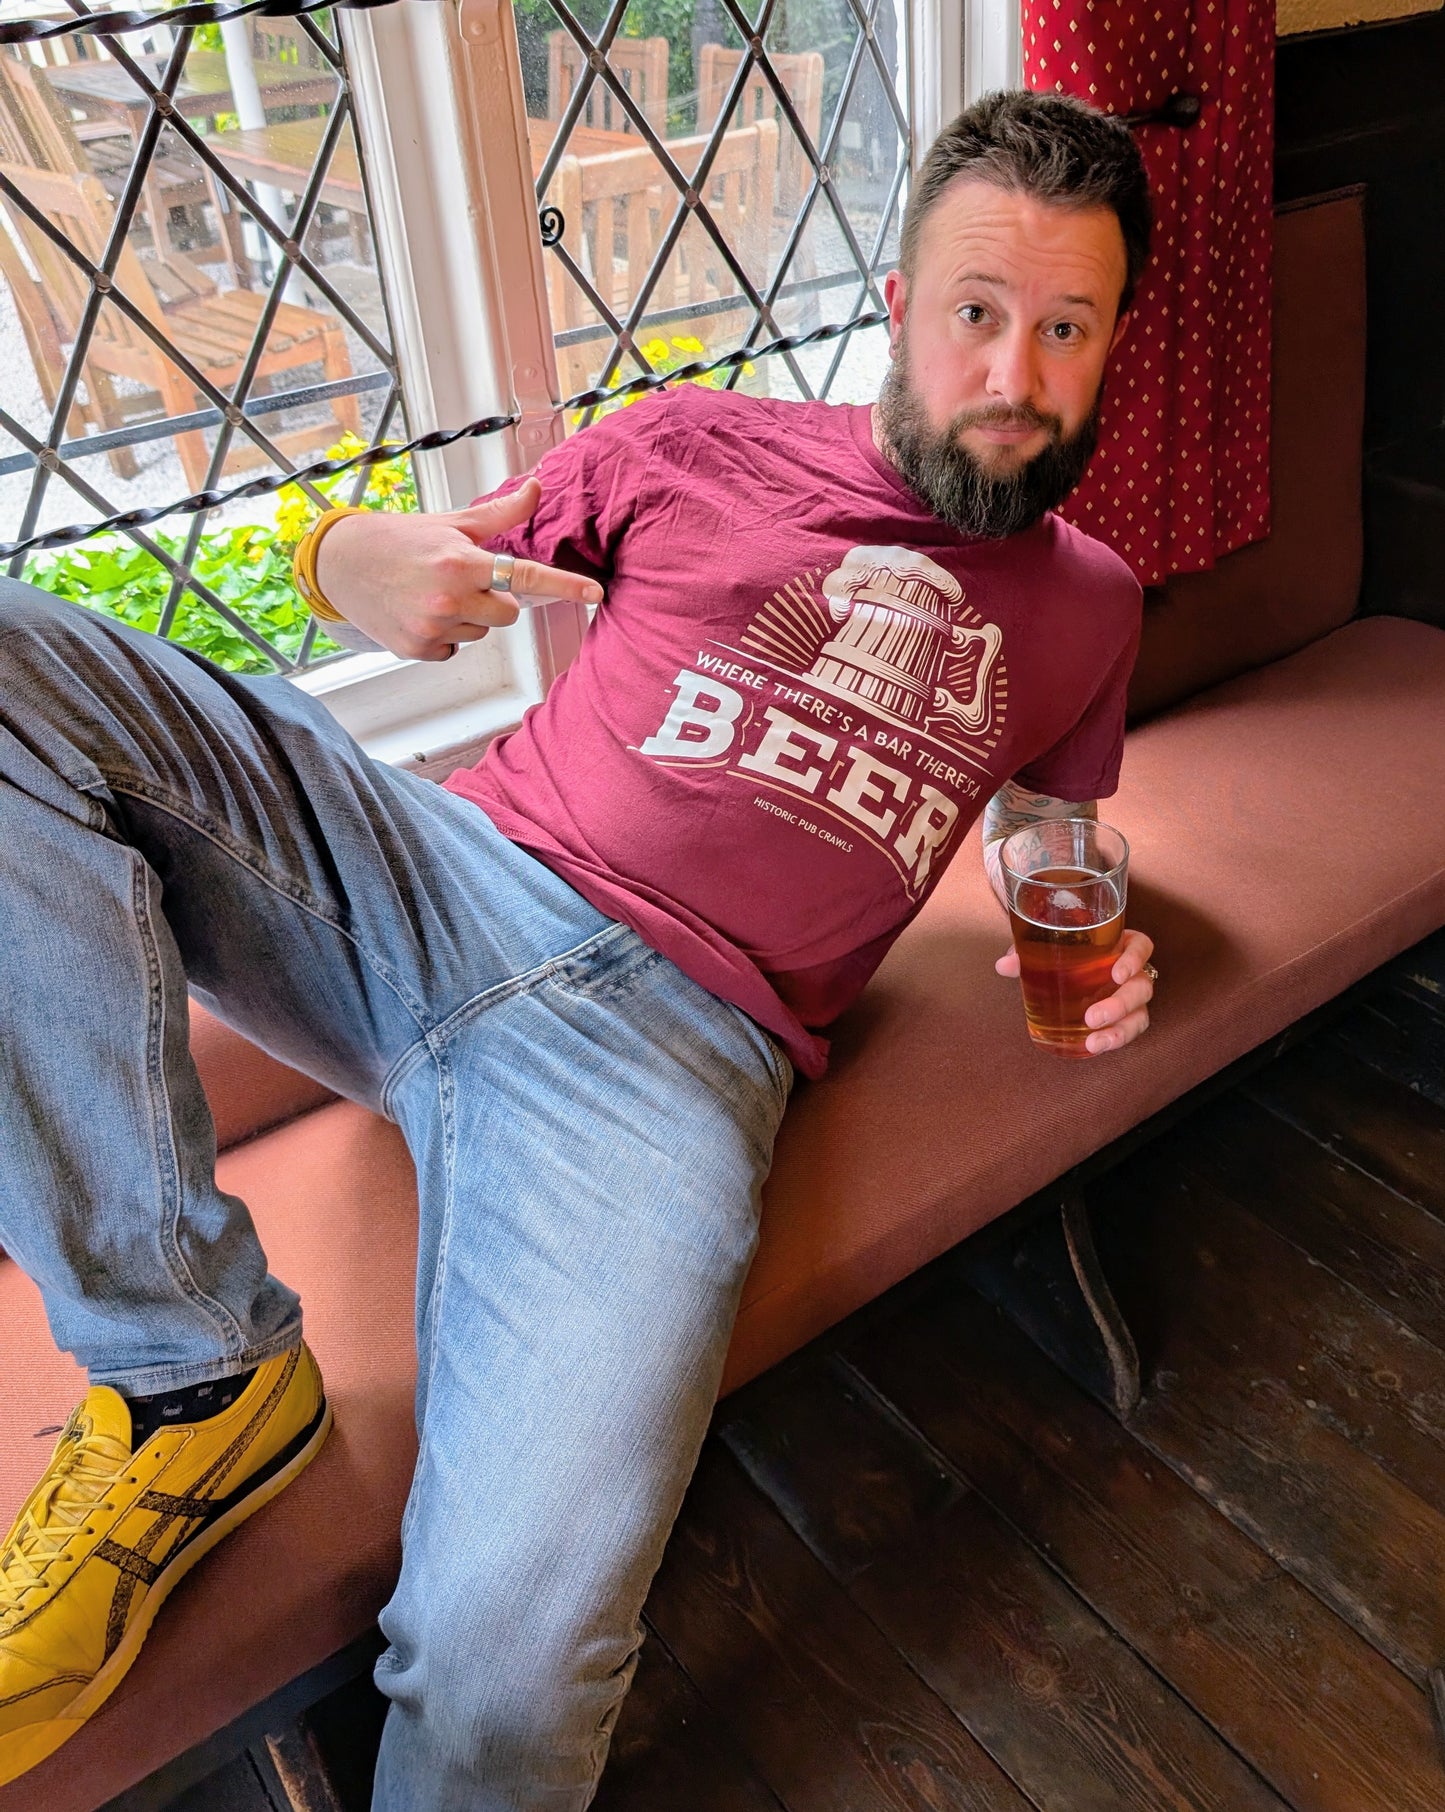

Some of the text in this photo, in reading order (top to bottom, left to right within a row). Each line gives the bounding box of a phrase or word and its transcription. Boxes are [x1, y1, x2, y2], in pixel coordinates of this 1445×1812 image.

[636, 668, 959, 890] BEER
[696, 650, 981, 800] WHERE THERE'S A BAR THERE'S A
[753, 796, 854, 853] HISTORIC PUB CRAWLS
